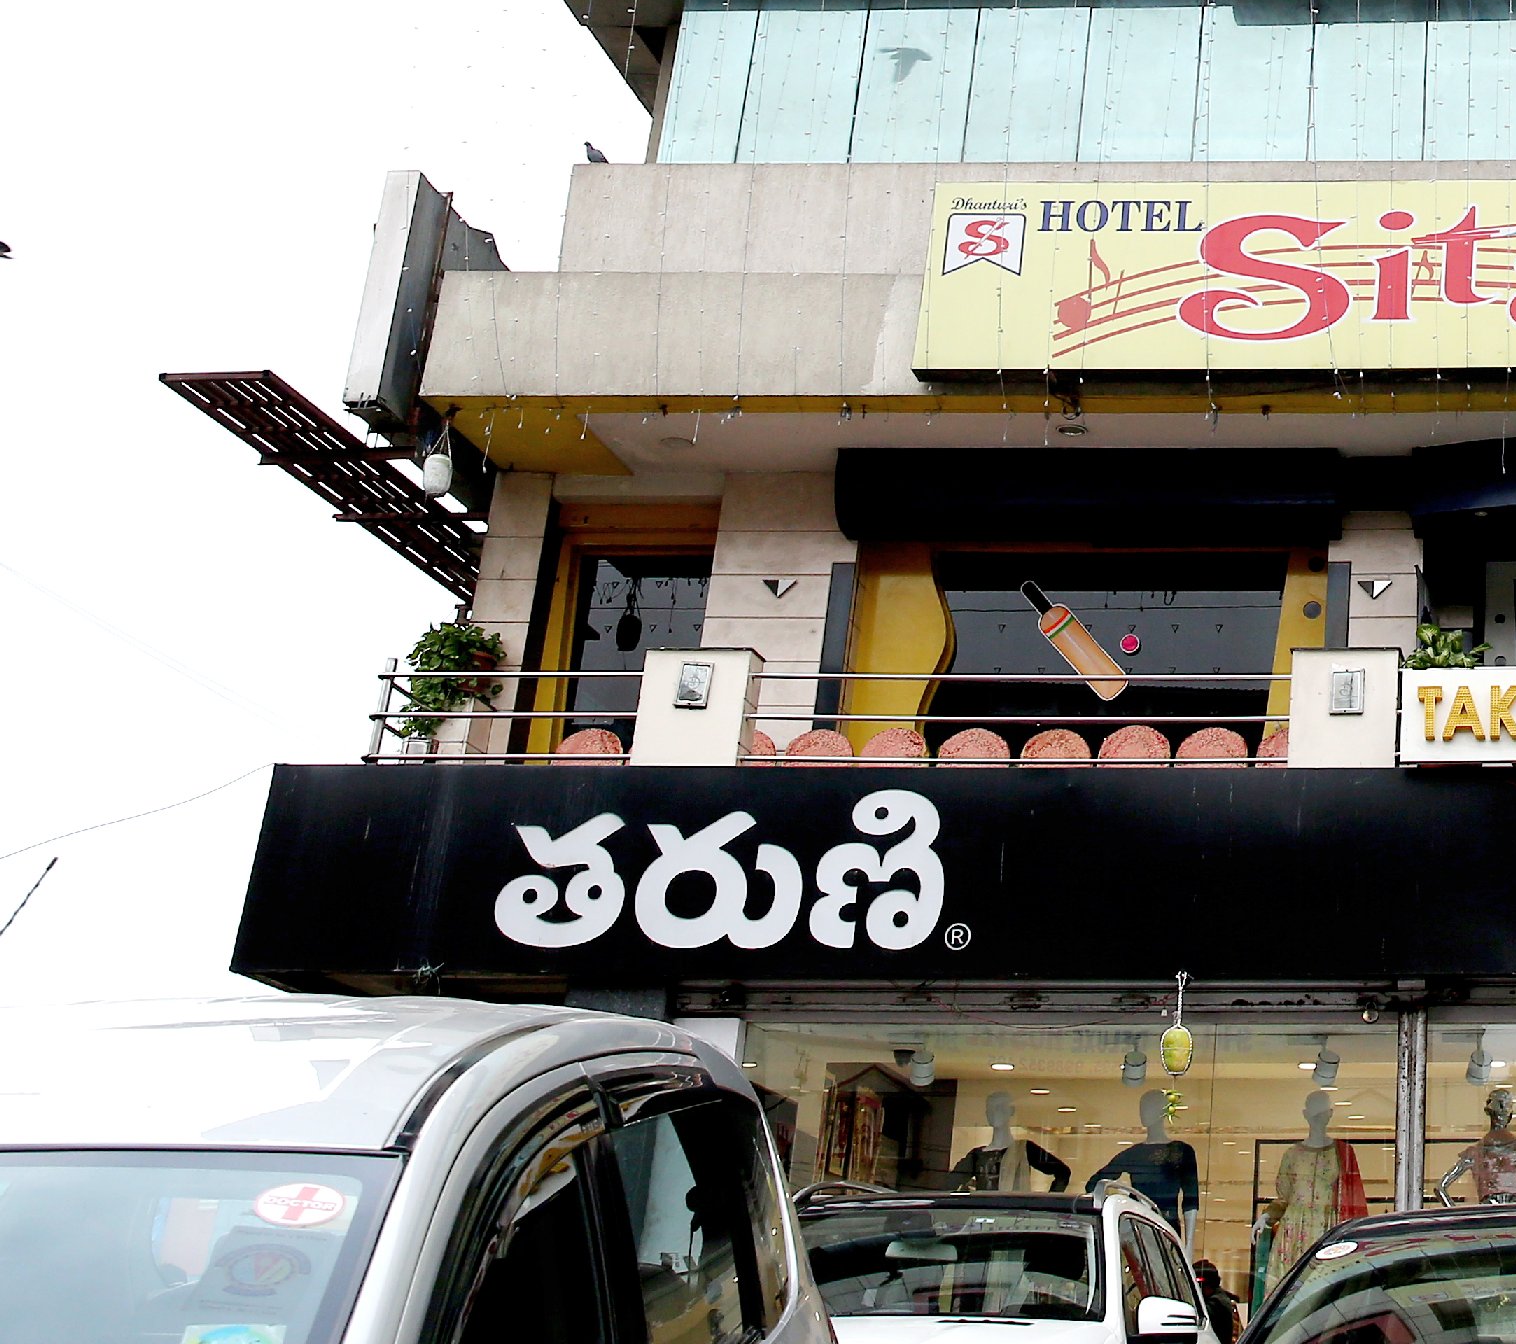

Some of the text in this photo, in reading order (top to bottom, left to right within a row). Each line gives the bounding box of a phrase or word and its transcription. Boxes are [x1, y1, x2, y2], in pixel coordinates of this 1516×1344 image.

[951, 196, 1028, 211] Dhanturi's
[1037, 199, 1205, 233] HOTEL
[265, 1195, 337, 1211] DOCTOR
